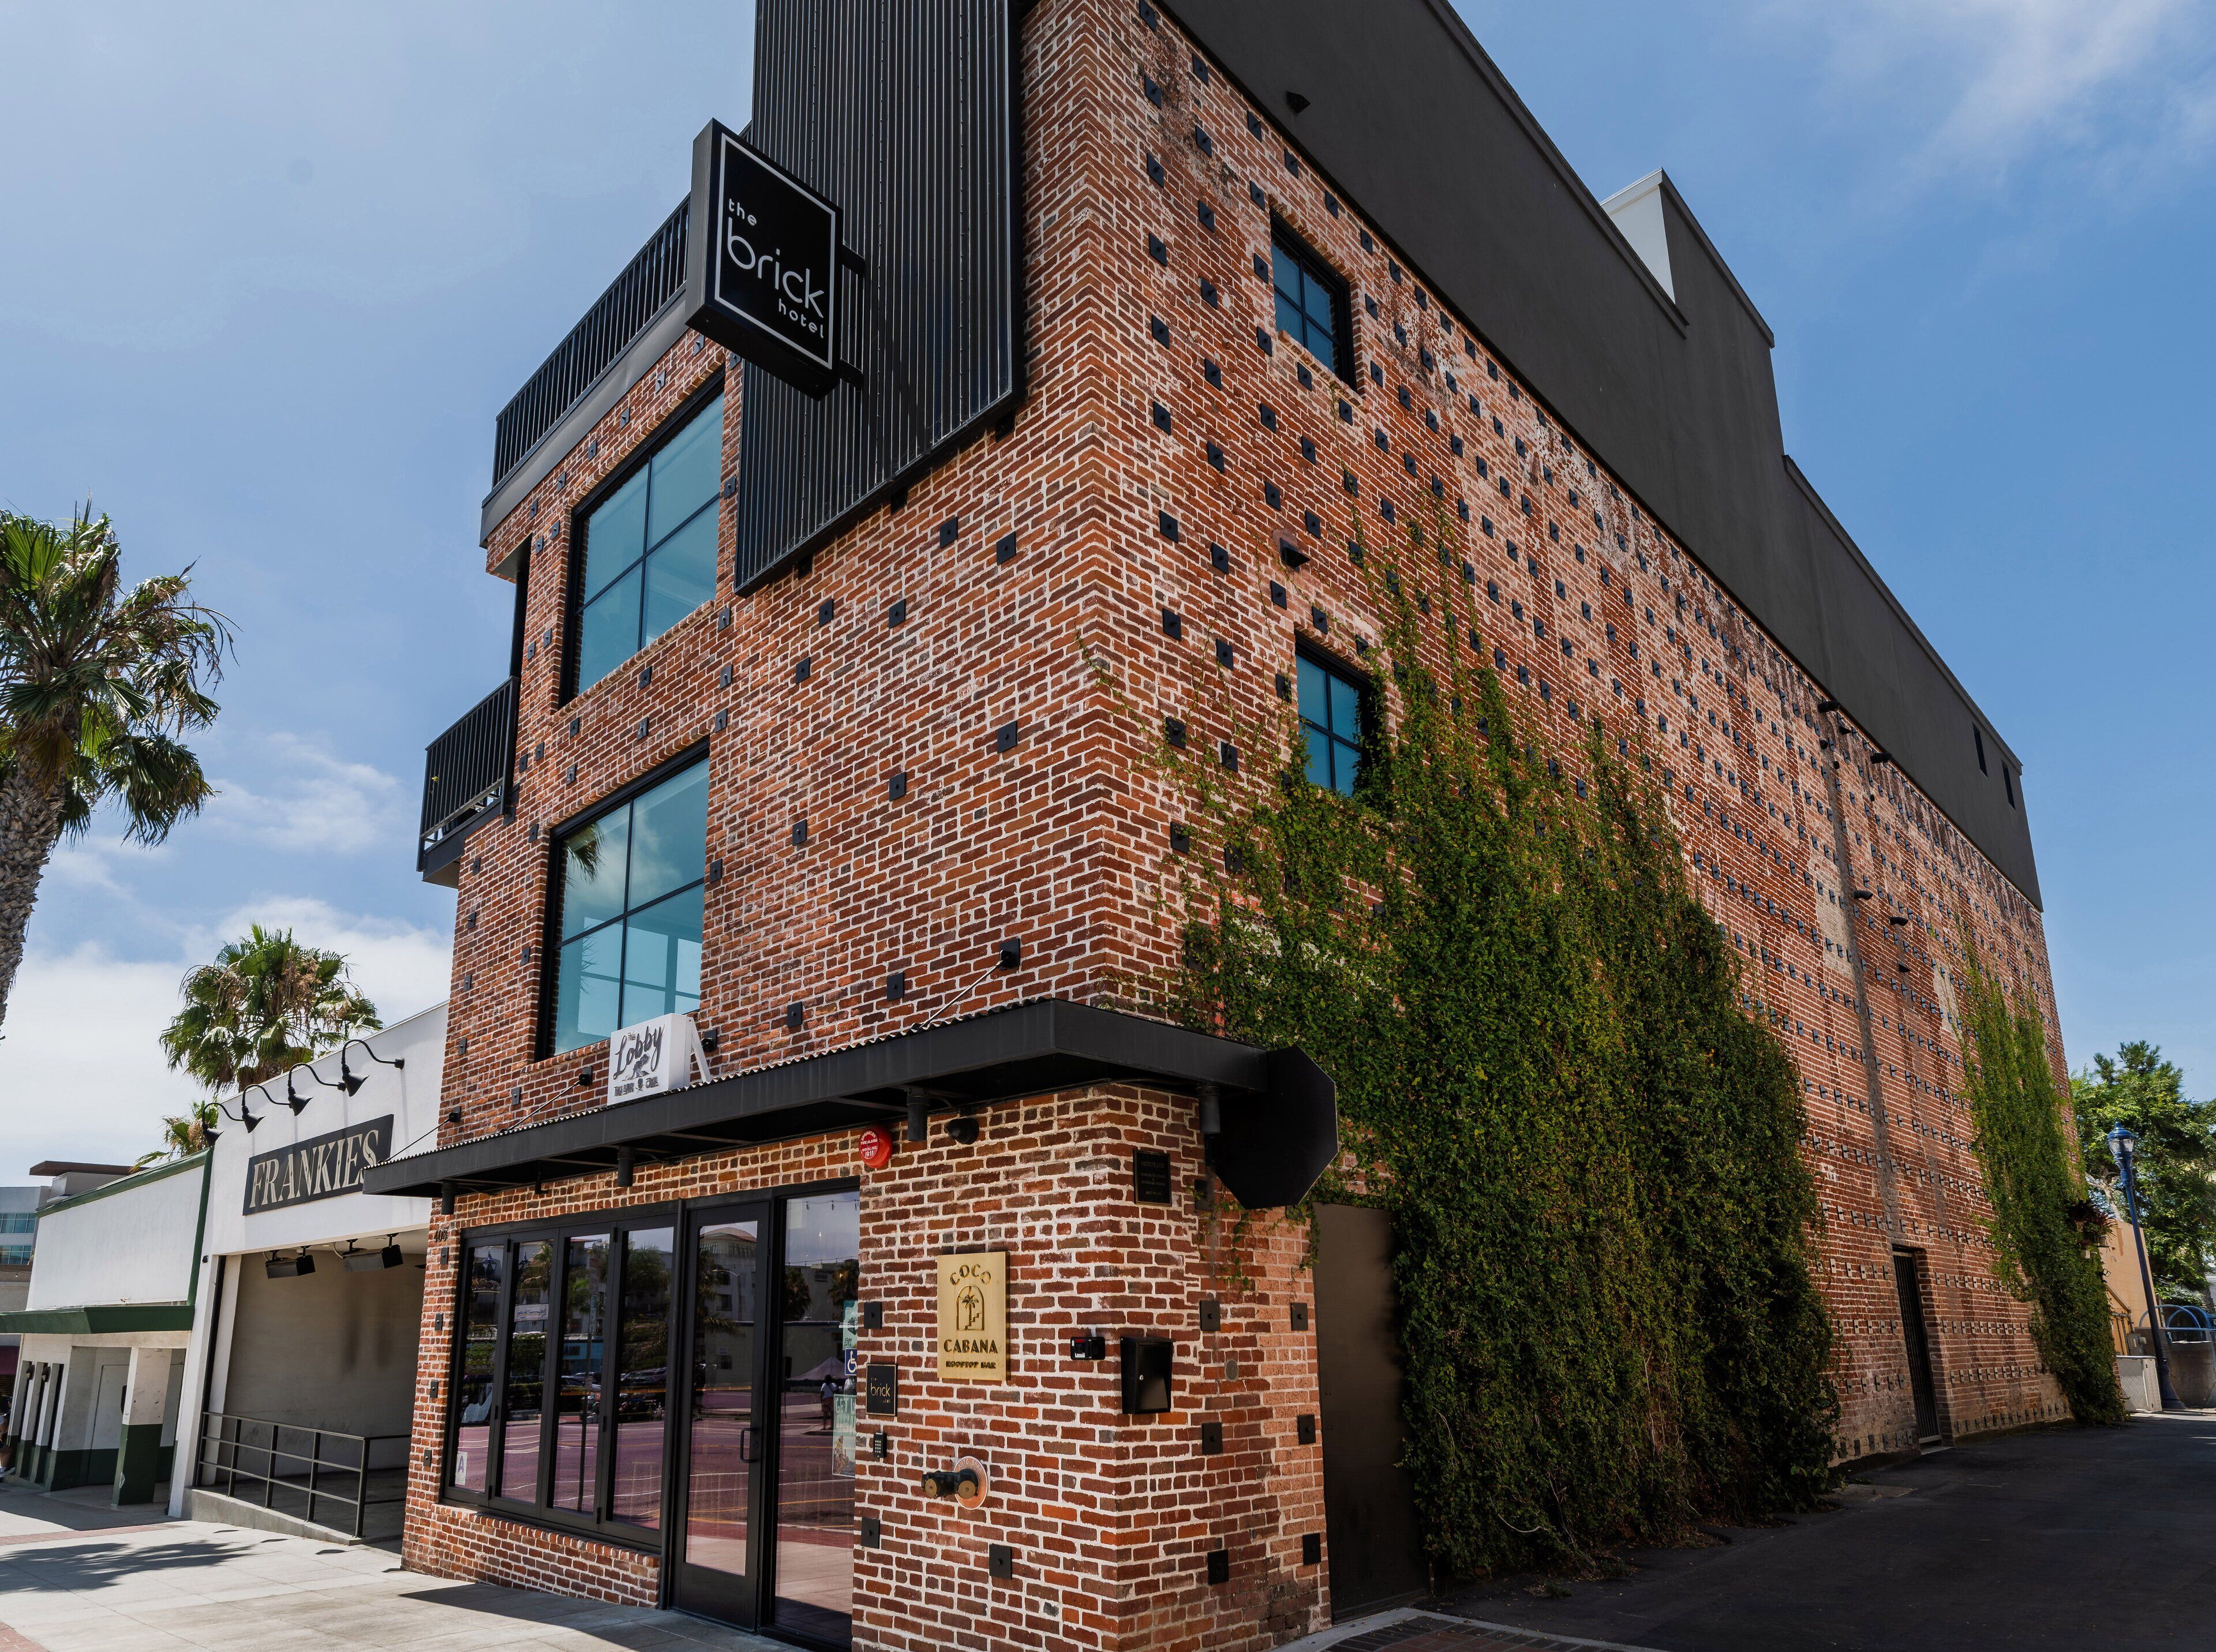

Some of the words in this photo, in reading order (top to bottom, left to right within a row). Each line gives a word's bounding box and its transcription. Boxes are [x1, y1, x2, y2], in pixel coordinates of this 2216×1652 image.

[728, 198, 757, 226] the
[727, 217, 825, 319] brick
[778, 298, 825, 339] hotel
[613, 1023, 665, 1080] Lobby
[434, 1229, 448, 1242] 408
[949, 1264, 991, 1286] COCO
[944, 1339, 998, 1354] CABANA
[870, 1383, 890, 1396] brick
[458, 1455, 464, 1473] A
[958, 1458, 969, 1469] AUTO
